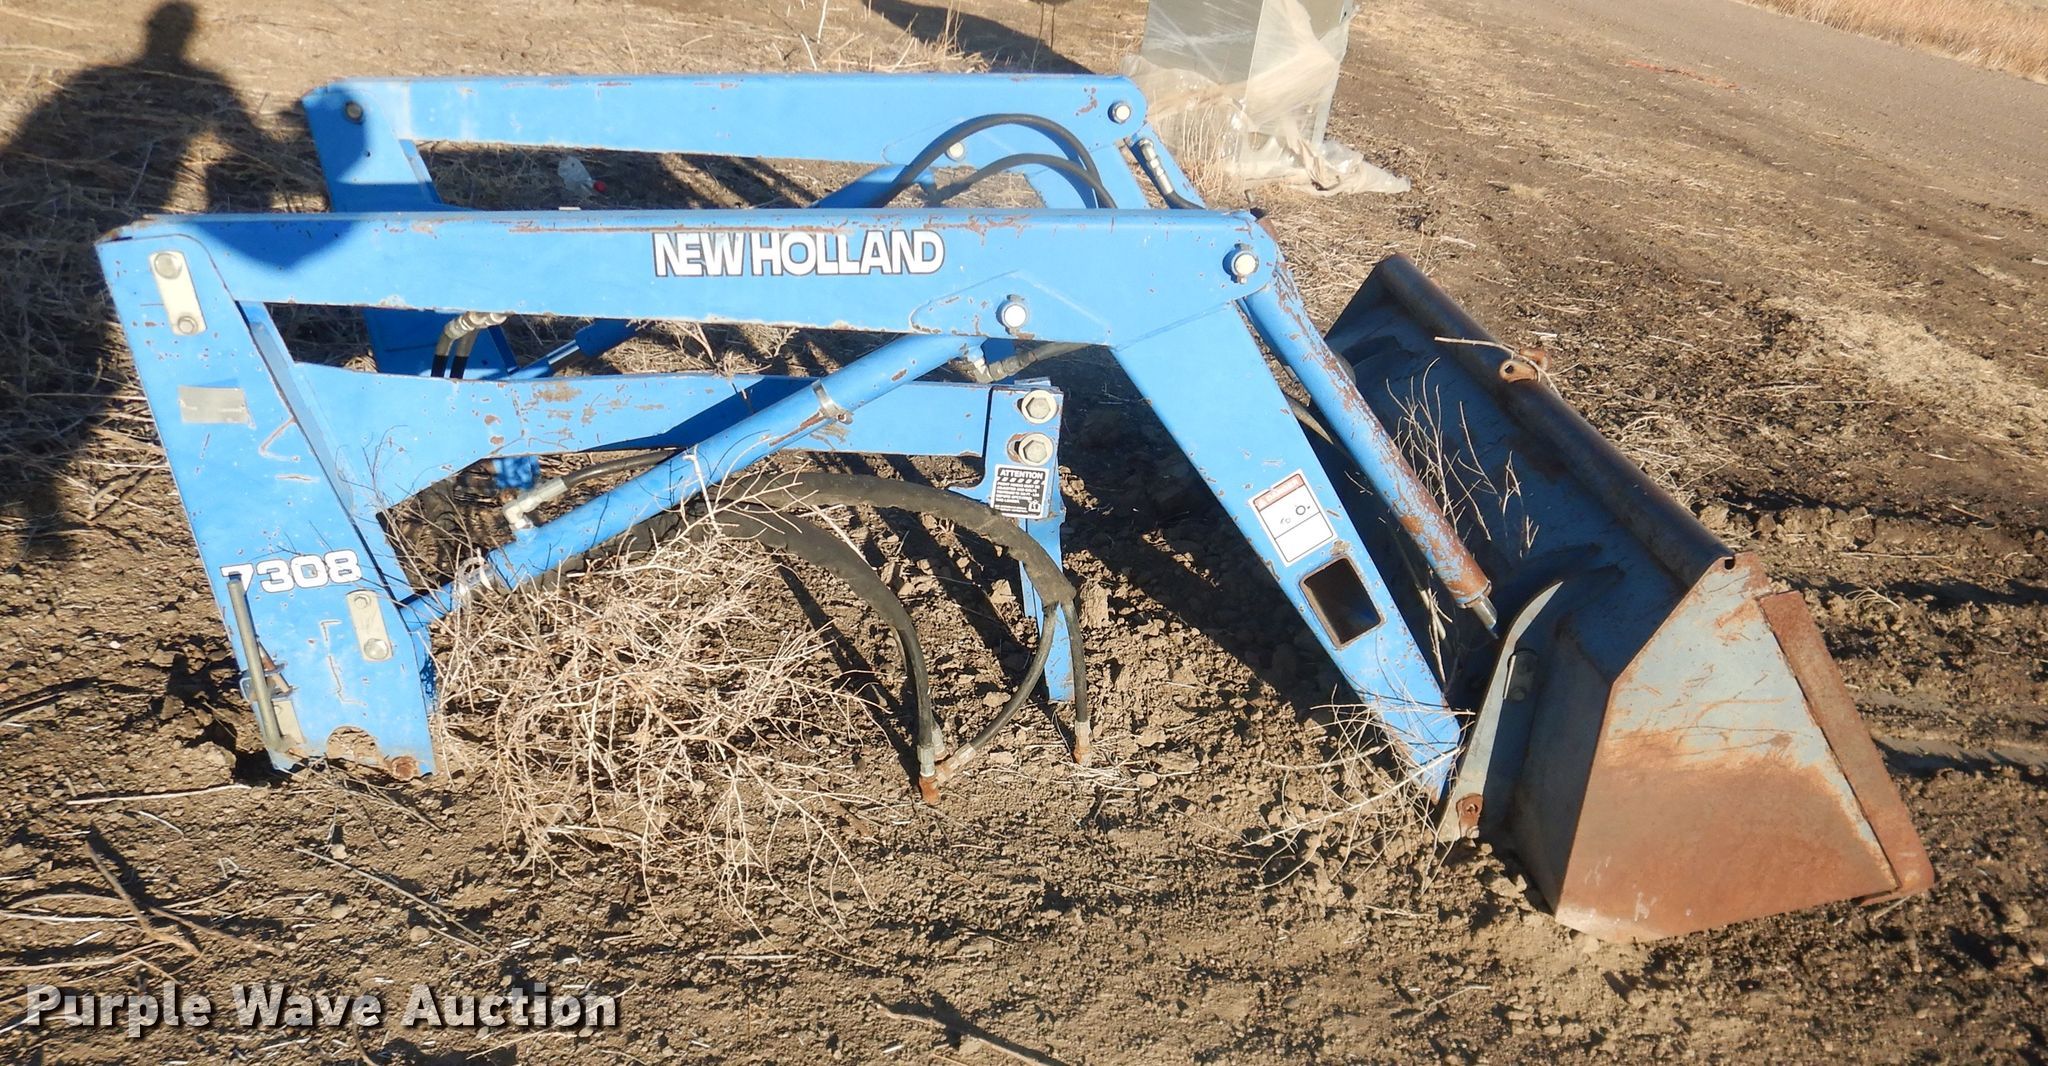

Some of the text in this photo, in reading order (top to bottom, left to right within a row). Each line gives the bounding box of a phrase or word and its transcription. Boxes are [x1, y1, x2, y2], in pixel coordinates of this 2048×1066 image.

[652, 229, 946, 277] NEW HOLLAND
[999, 469, 1044, 480] ATTENTION
[219, 549, 362, 593] 7308
